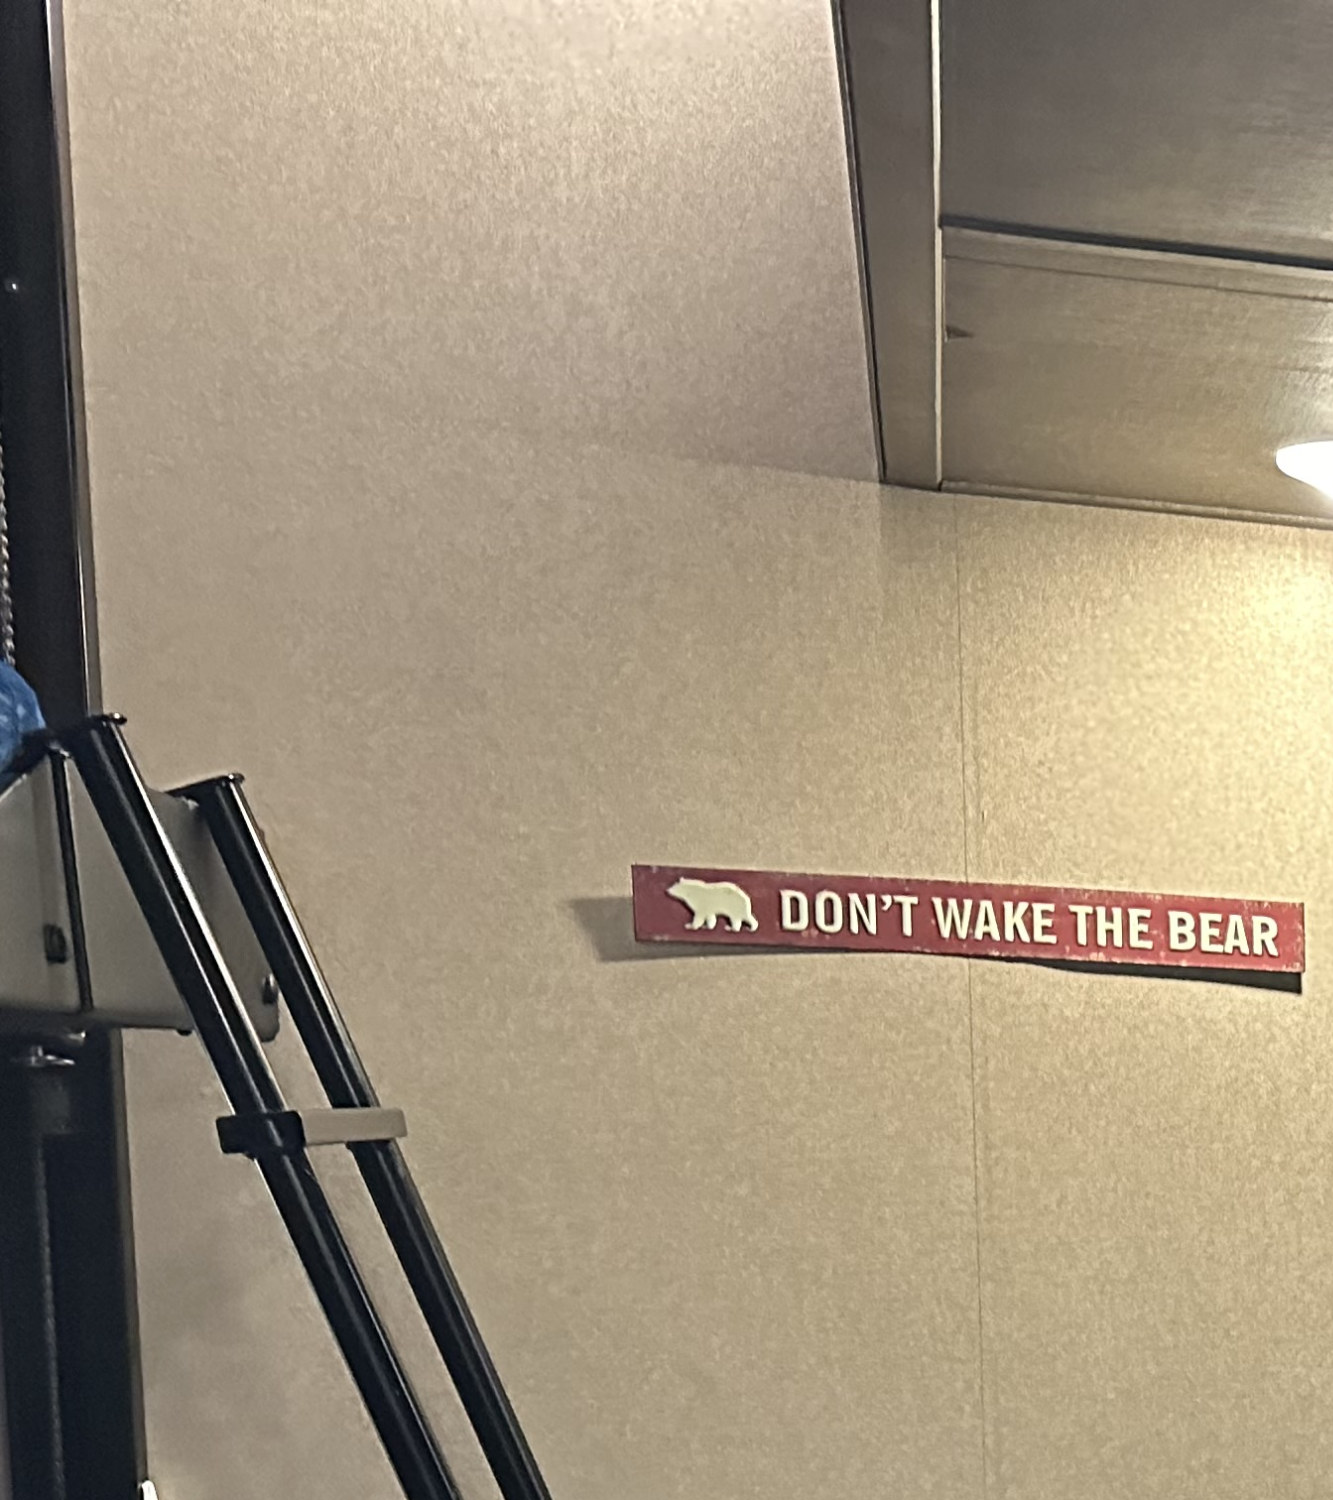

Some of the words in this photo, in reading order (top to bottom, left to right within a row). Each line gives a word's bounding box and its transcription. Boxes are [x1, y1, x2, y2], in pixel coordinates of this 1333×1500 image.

[780, 888, 919, 937] DON'T
[932, 896, 1057, 945] WAKE
[1069, 903, 1153, 950] THE
[1168, 910, 1279, 957] BEAR
